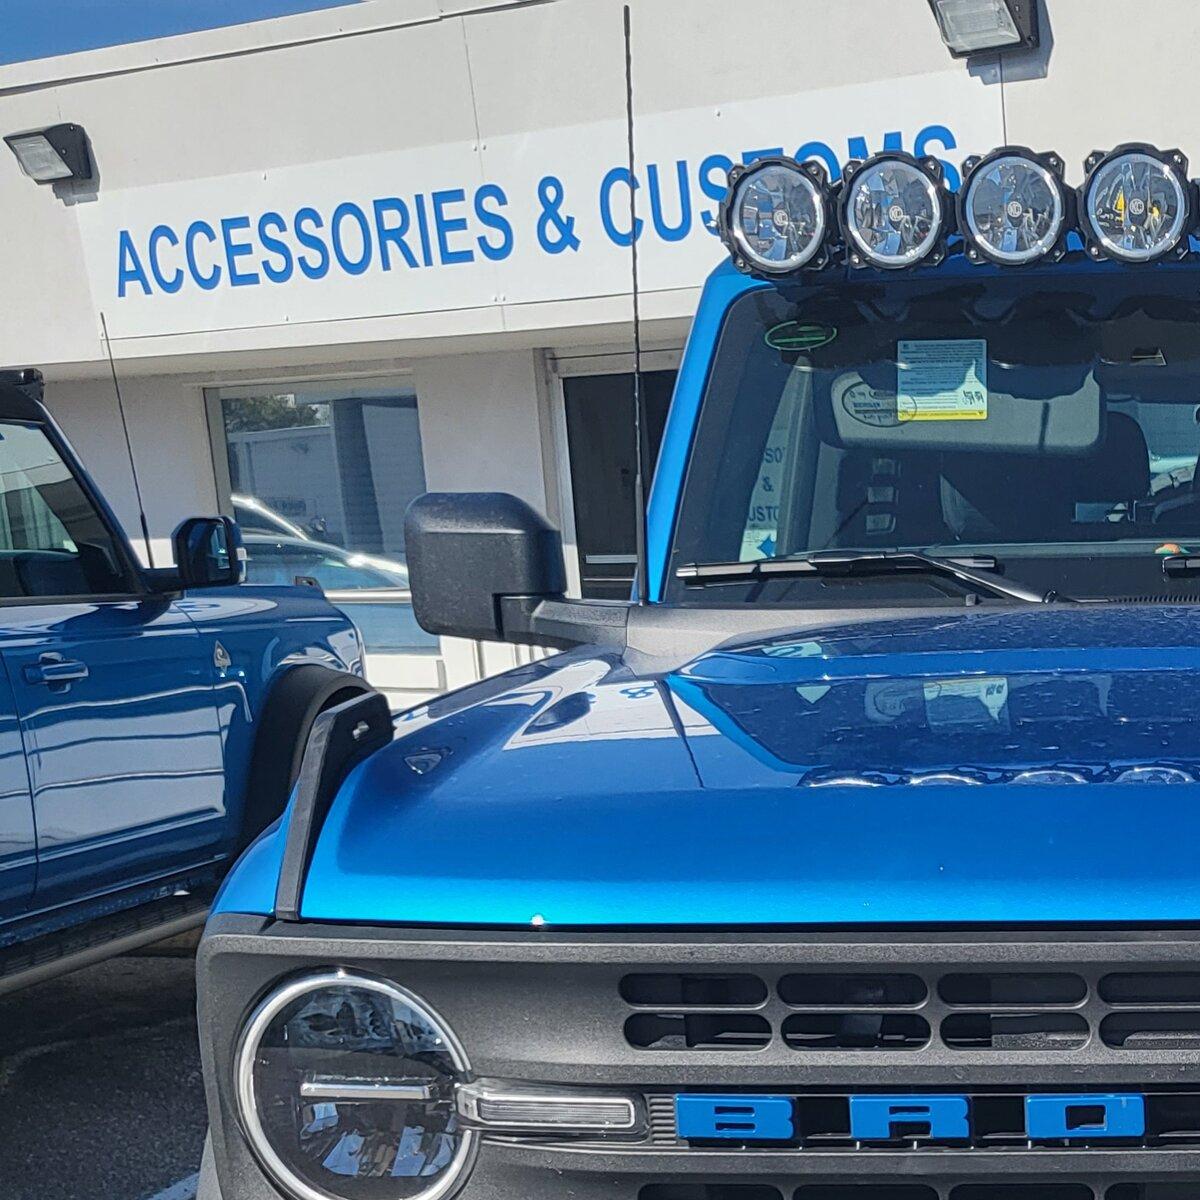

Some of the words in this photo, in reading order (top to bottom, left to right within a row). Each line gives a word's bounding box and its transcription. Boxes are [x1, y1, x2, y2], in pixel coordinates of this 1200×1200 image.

[117, 183, 514, 298] ACCESSORIES
[536, 175, 581, 255] &
[600, 125, 962, 247] CUSS
